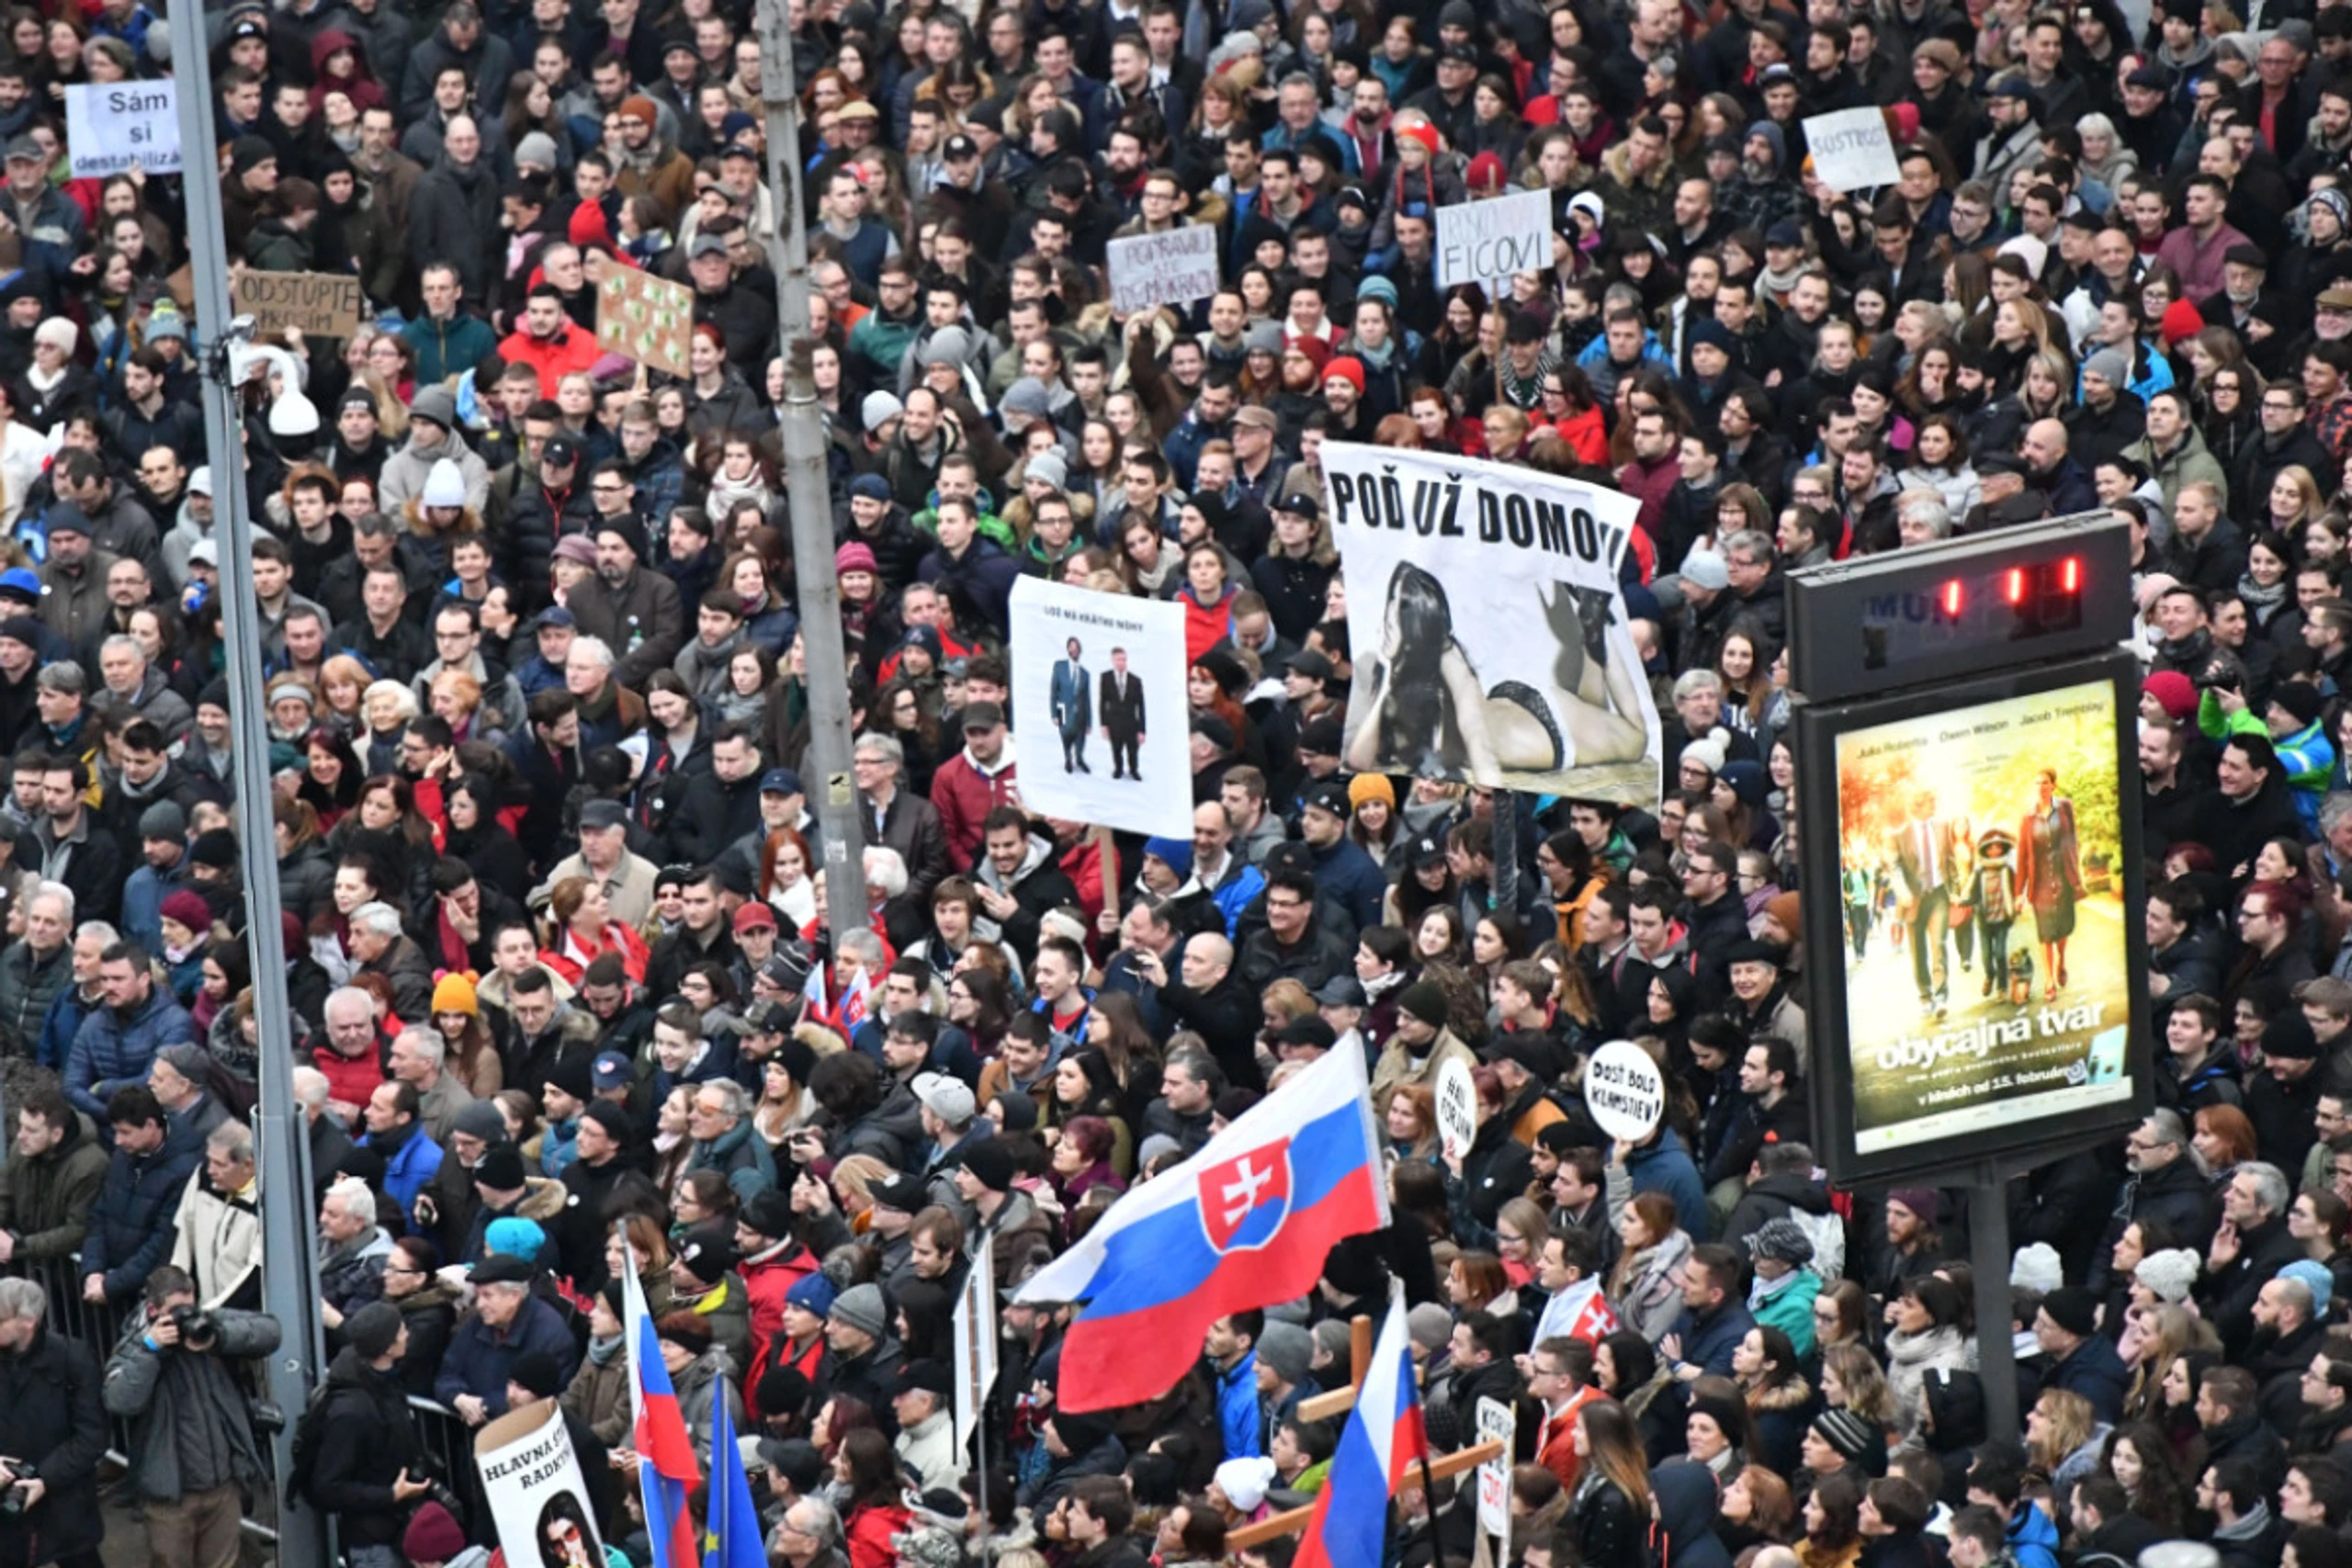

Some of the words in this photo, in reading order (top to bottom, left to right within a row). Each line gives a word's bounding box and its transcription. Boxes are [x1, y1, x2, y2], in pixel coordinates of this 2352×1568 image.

[109, 91, 167, 113] Sám
[130, 121, 152, 144] si
[1445, 231, 1542, 283] FICOVI
[241, 275, 357, 312] ODSTÚPTE
[1329, 465, 1405, 531] POĎ
[1412, 471, 1464, 537] UŽ
[2020, 710, 2052, 726] Jacob
[1878, 1008, 2031, 1069] obyčajná
[2038, 995, 2106, 1037] tvár
[1628, 1070, 1656, 1095] BOLO
[1973, 1078, 1990, 1094] od
[1991, 1074, 2015, 1089] 15.
